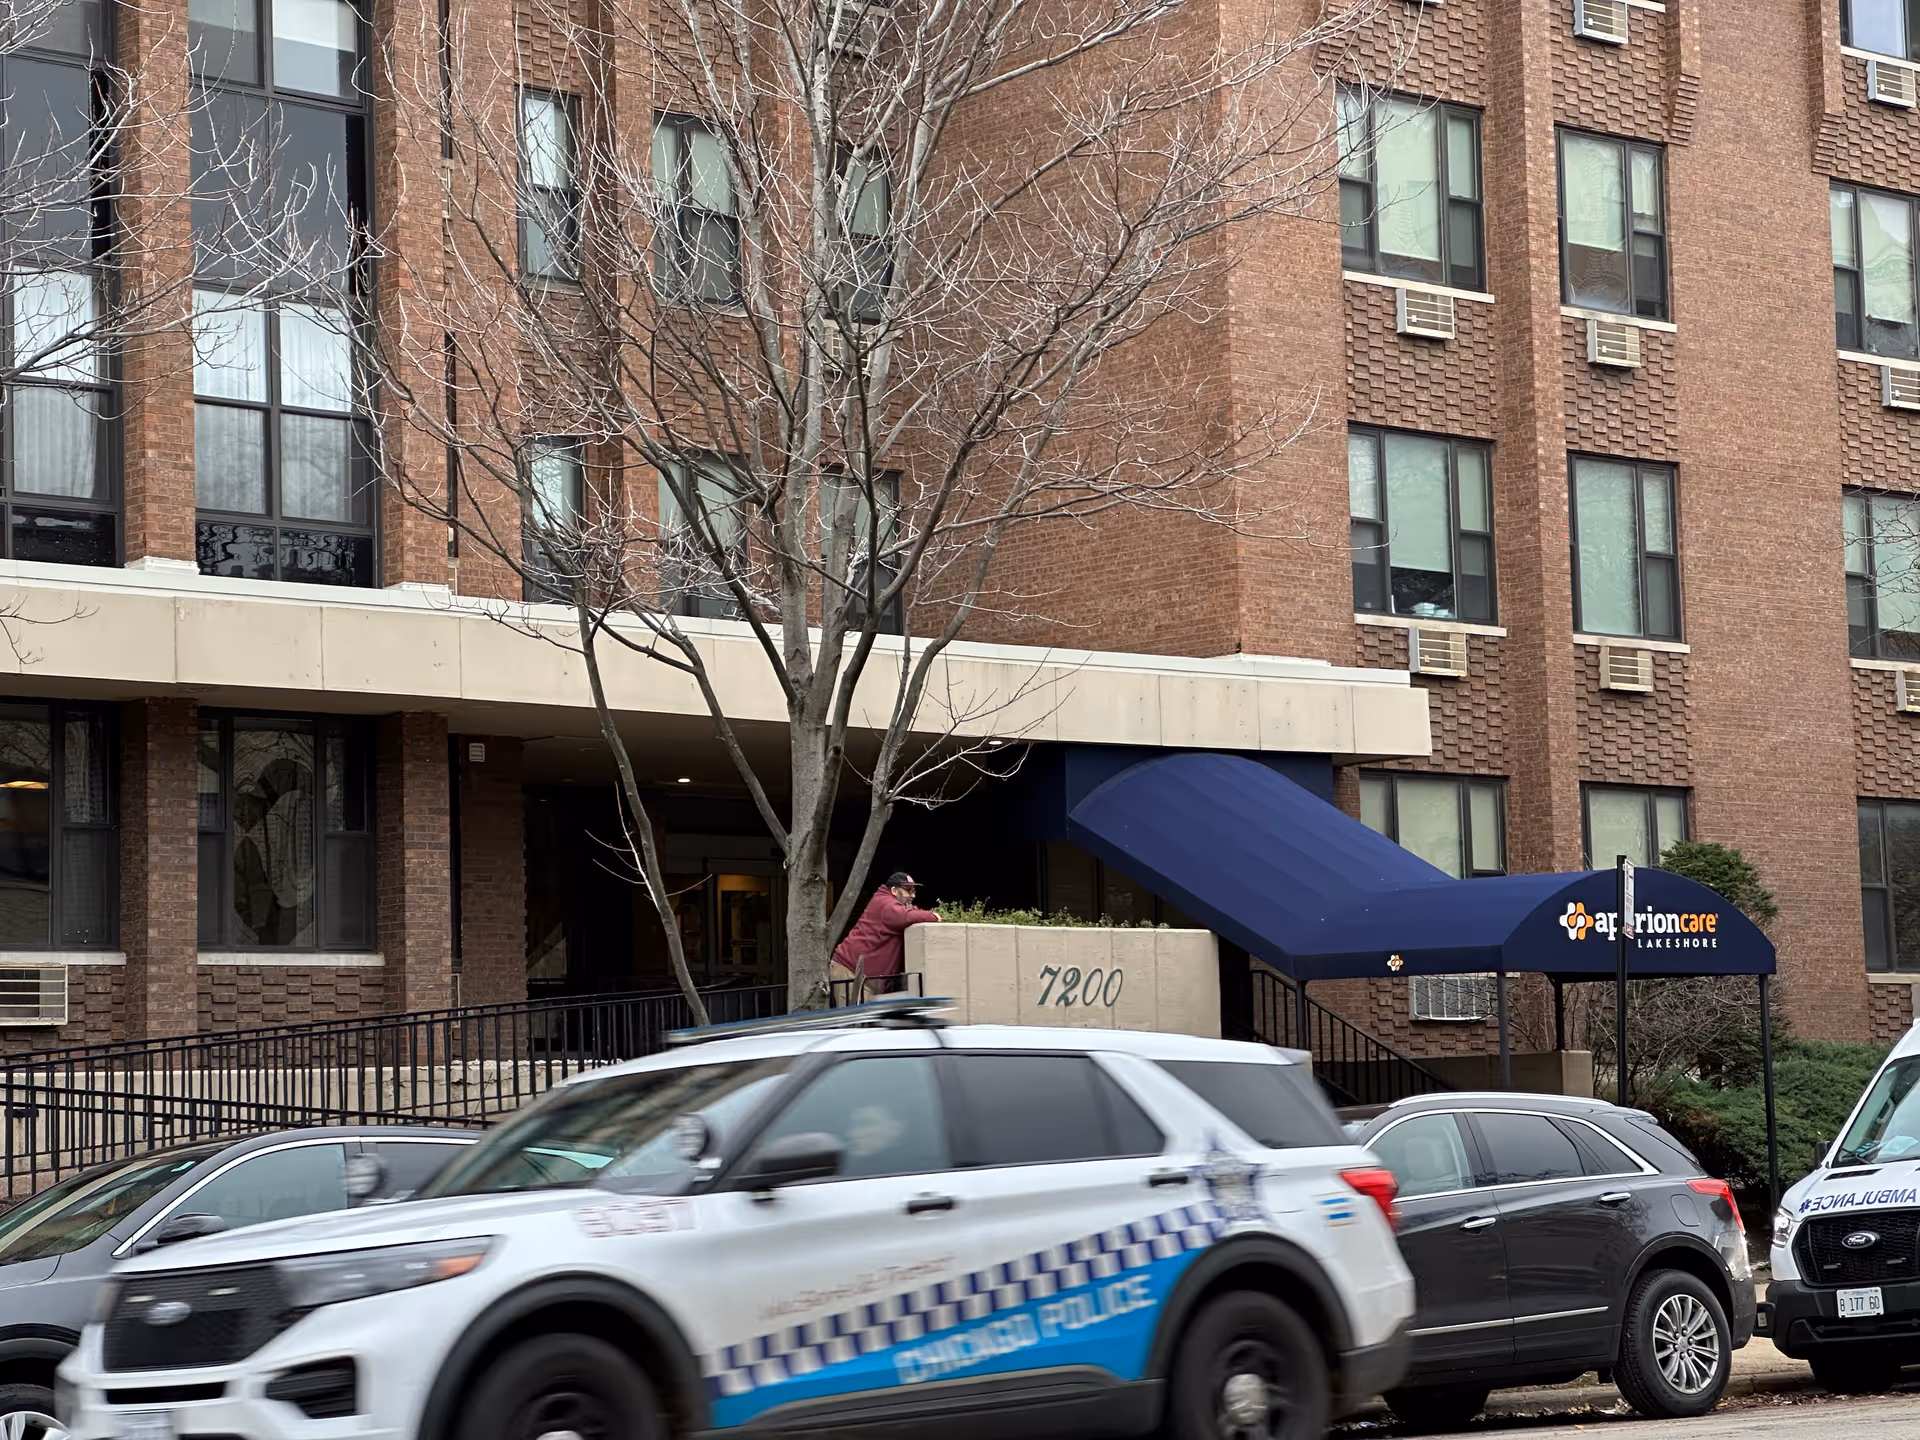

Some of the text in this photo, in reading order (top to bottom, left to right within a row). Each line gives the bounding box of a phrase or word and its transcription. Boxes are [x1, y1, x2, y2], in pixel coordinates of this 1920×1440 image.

[1595, 905, 1716, 941] aprioncare
[1637, 938, 1718, 949] LAKESHORE
[1037, 965, 1123, 1007] 7200
[893, 1313, 1040, 1385] CHICAGO
[1037, 1274, 1158, 1338] POLICE
